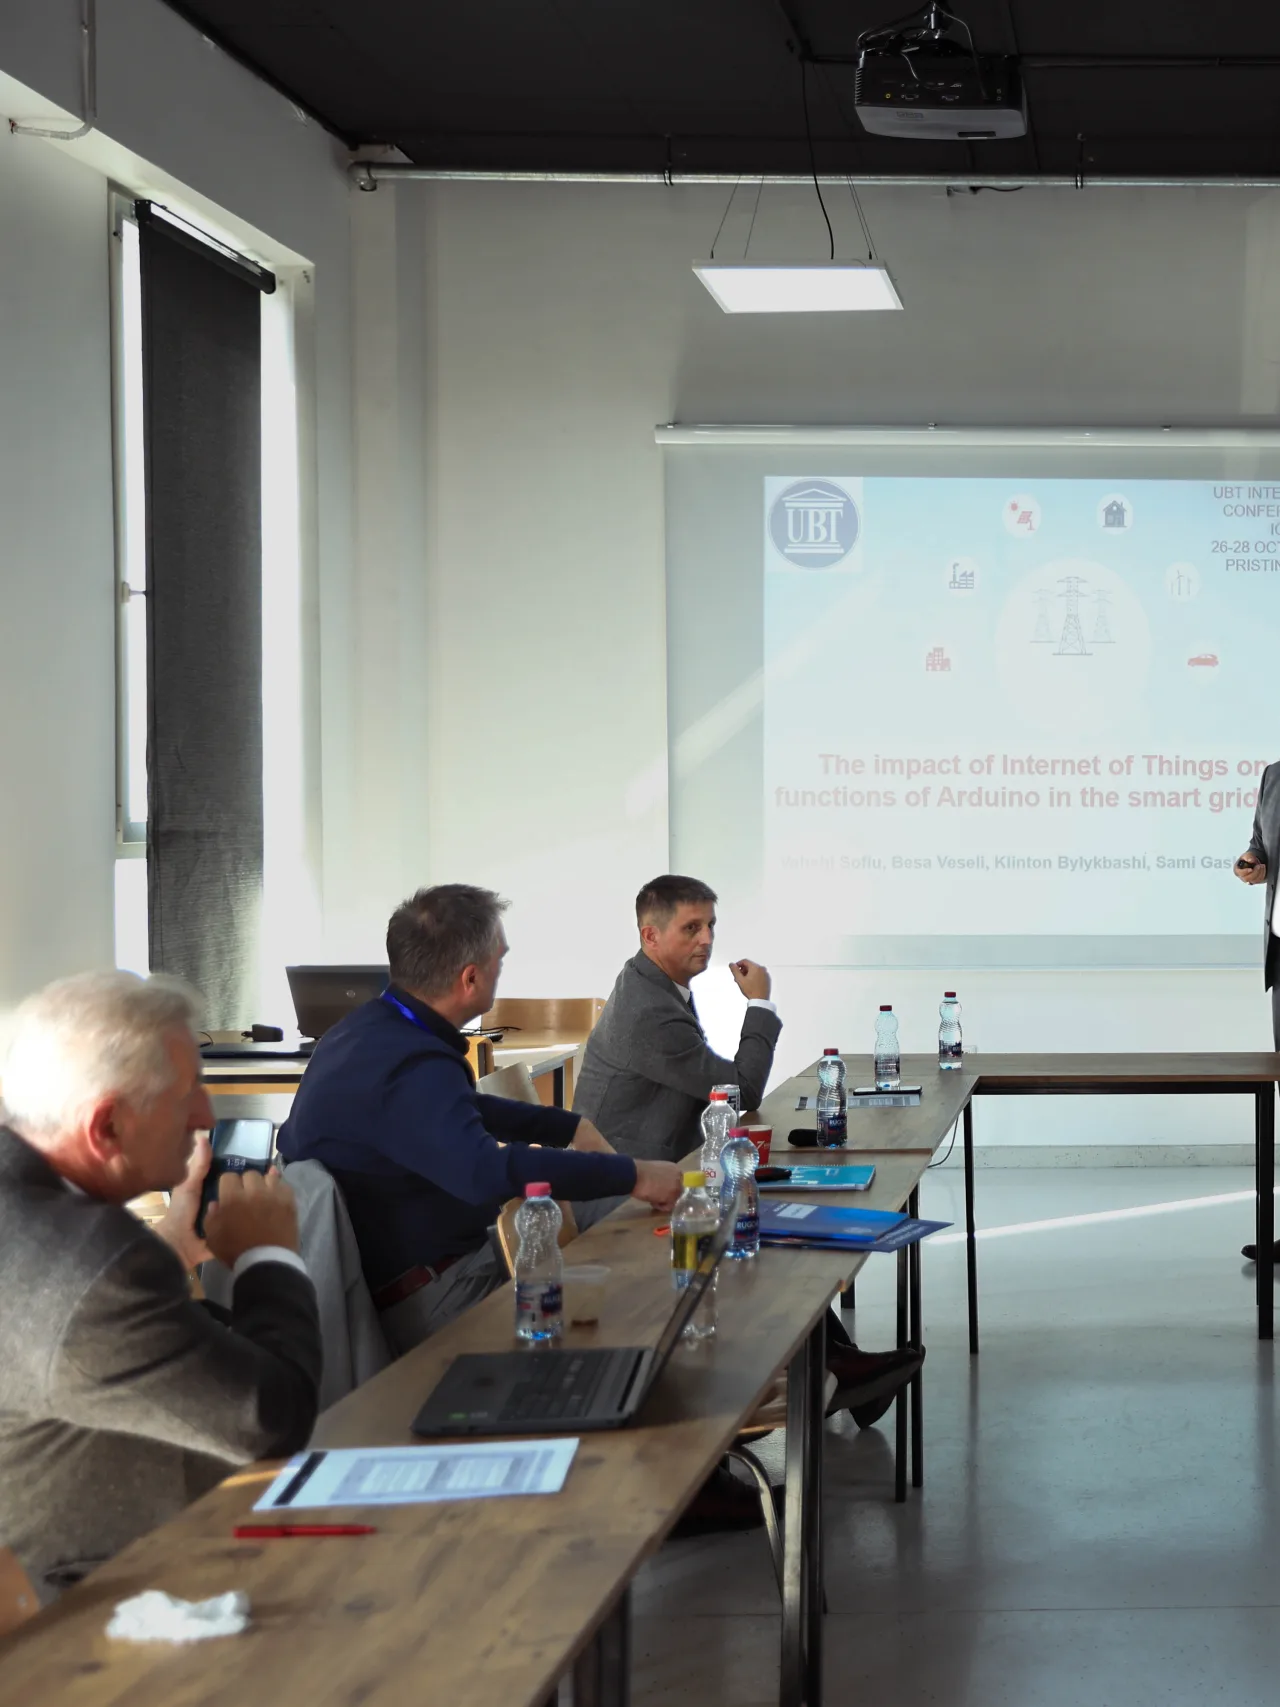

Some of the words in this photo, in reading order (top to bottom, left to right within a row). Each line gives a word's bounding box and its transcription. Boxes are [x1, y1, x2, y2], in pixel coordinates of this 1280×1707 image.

[1213, 487, 1243, 499] UBT
[786, 508, 843, 543] UBT
[1211, 540, 1250, 554] 26-28
[818, 754, 866, 775] The
[874, 754, 961, 780] impact
[969, 754, 995, 775] of
[1003, 754, 1101, 775] Internet
[1108, 754, 1134, 775] of
[1142, 754, 1229, 781] Things
[774, 786, 897, 807] functions
[905, 786, 931, 807] of
[936, 786, 1040, 807] Arduino
[1049, 787, 1072, 808] in
[1080, 787, 1120, 808] the
[1128, 787, 1201, 808] smart
[892, 855, 932, 869] Besa
[936, 855, 990, 871] Veseli,
[995, 855, 1053, 869] Klinton
[1156, 855, 1196, 869] Sami
